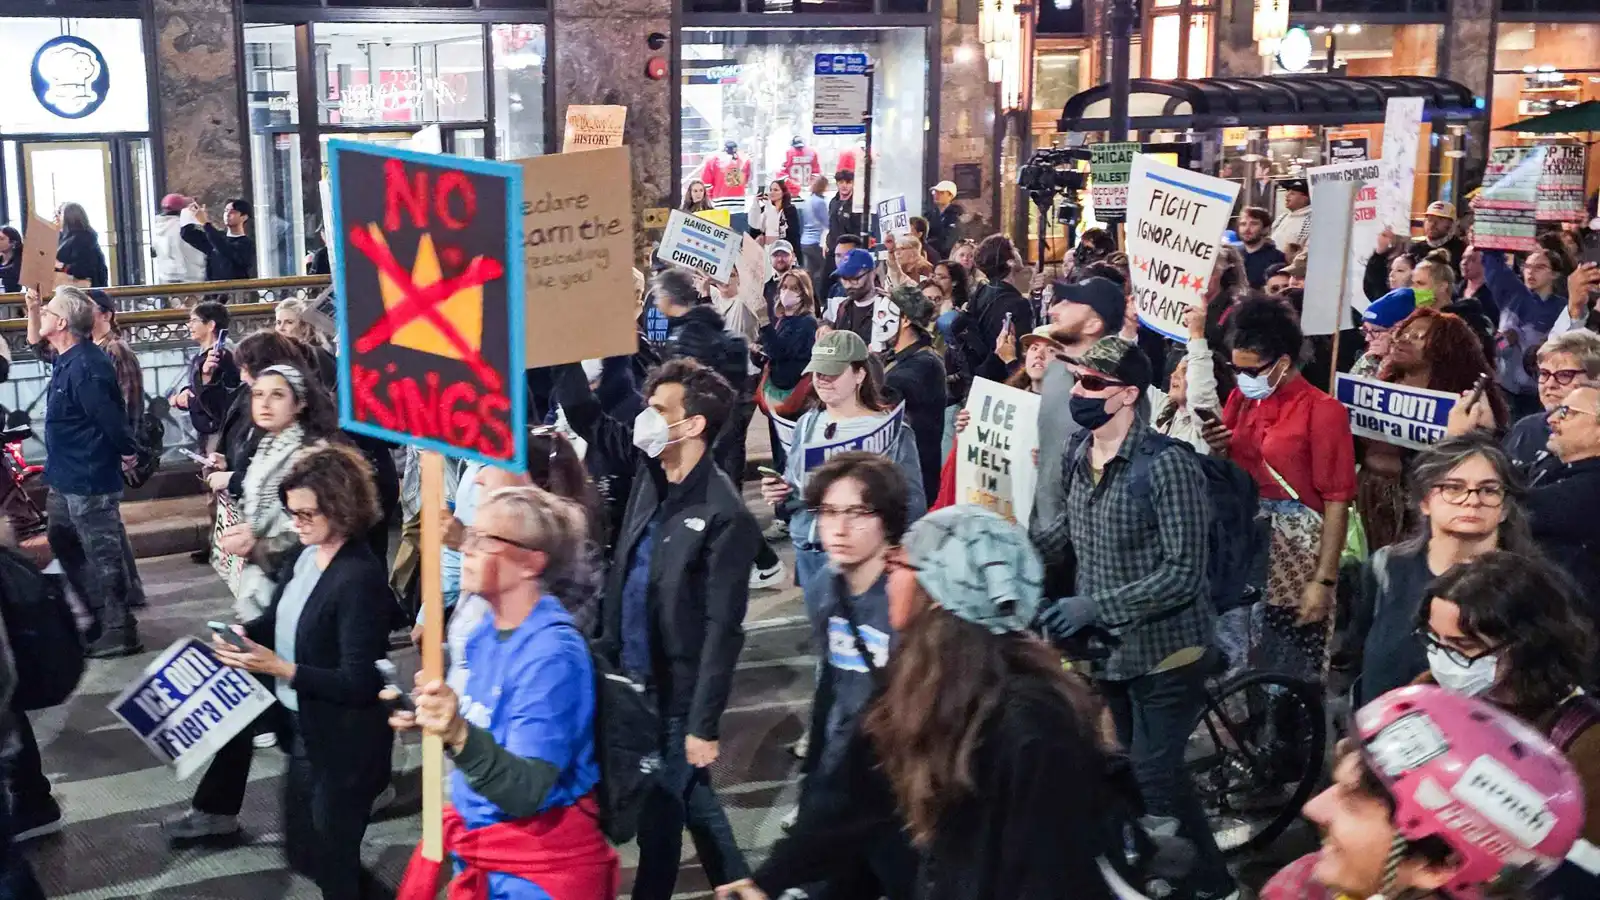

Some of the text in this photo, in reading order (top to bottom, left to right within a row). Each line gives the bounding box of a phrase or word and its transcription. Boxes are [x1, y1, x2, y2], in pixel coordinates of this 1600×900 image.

[573, 134, 611, 146] HISTORY
[1563, 147, 1584, 158] THE
[1091, 151, 1132, 164] CHICAG
[1092, 172, 1130, 183] PALESTI
[1344, 165, 1379, 180] CHICAGO
[384, 157, 477, 232] NO
[1093, 187, 1128, 196] OCCUPAT
[1105, 197, 1111, 206] A
[1149, 189, 1207, 225] FIGHT
[1355, 206, 1377, 221] STEIN
[579, 215, 624, 240] the
[683, 217, 711, 235] HANDS
[713, 228, 730, 241] OFF
[1137, 218, 1213, 260] IGNORANCE
[671, 250, 718, 276] CHICAGO
[1148, 258, 1186, 288] NOT
[980, 395, 1017, 431] ICE
[1353, 384, 1437, 424] ICE OUT!
[977, 425, 1011, 451] WILL
[967, 444, 1012, 475] MELT
[981, 473, 998, 492] IN
[134, 646, 219, 723] ICE OUT!
[209, 667, 255, 711] ICE!
